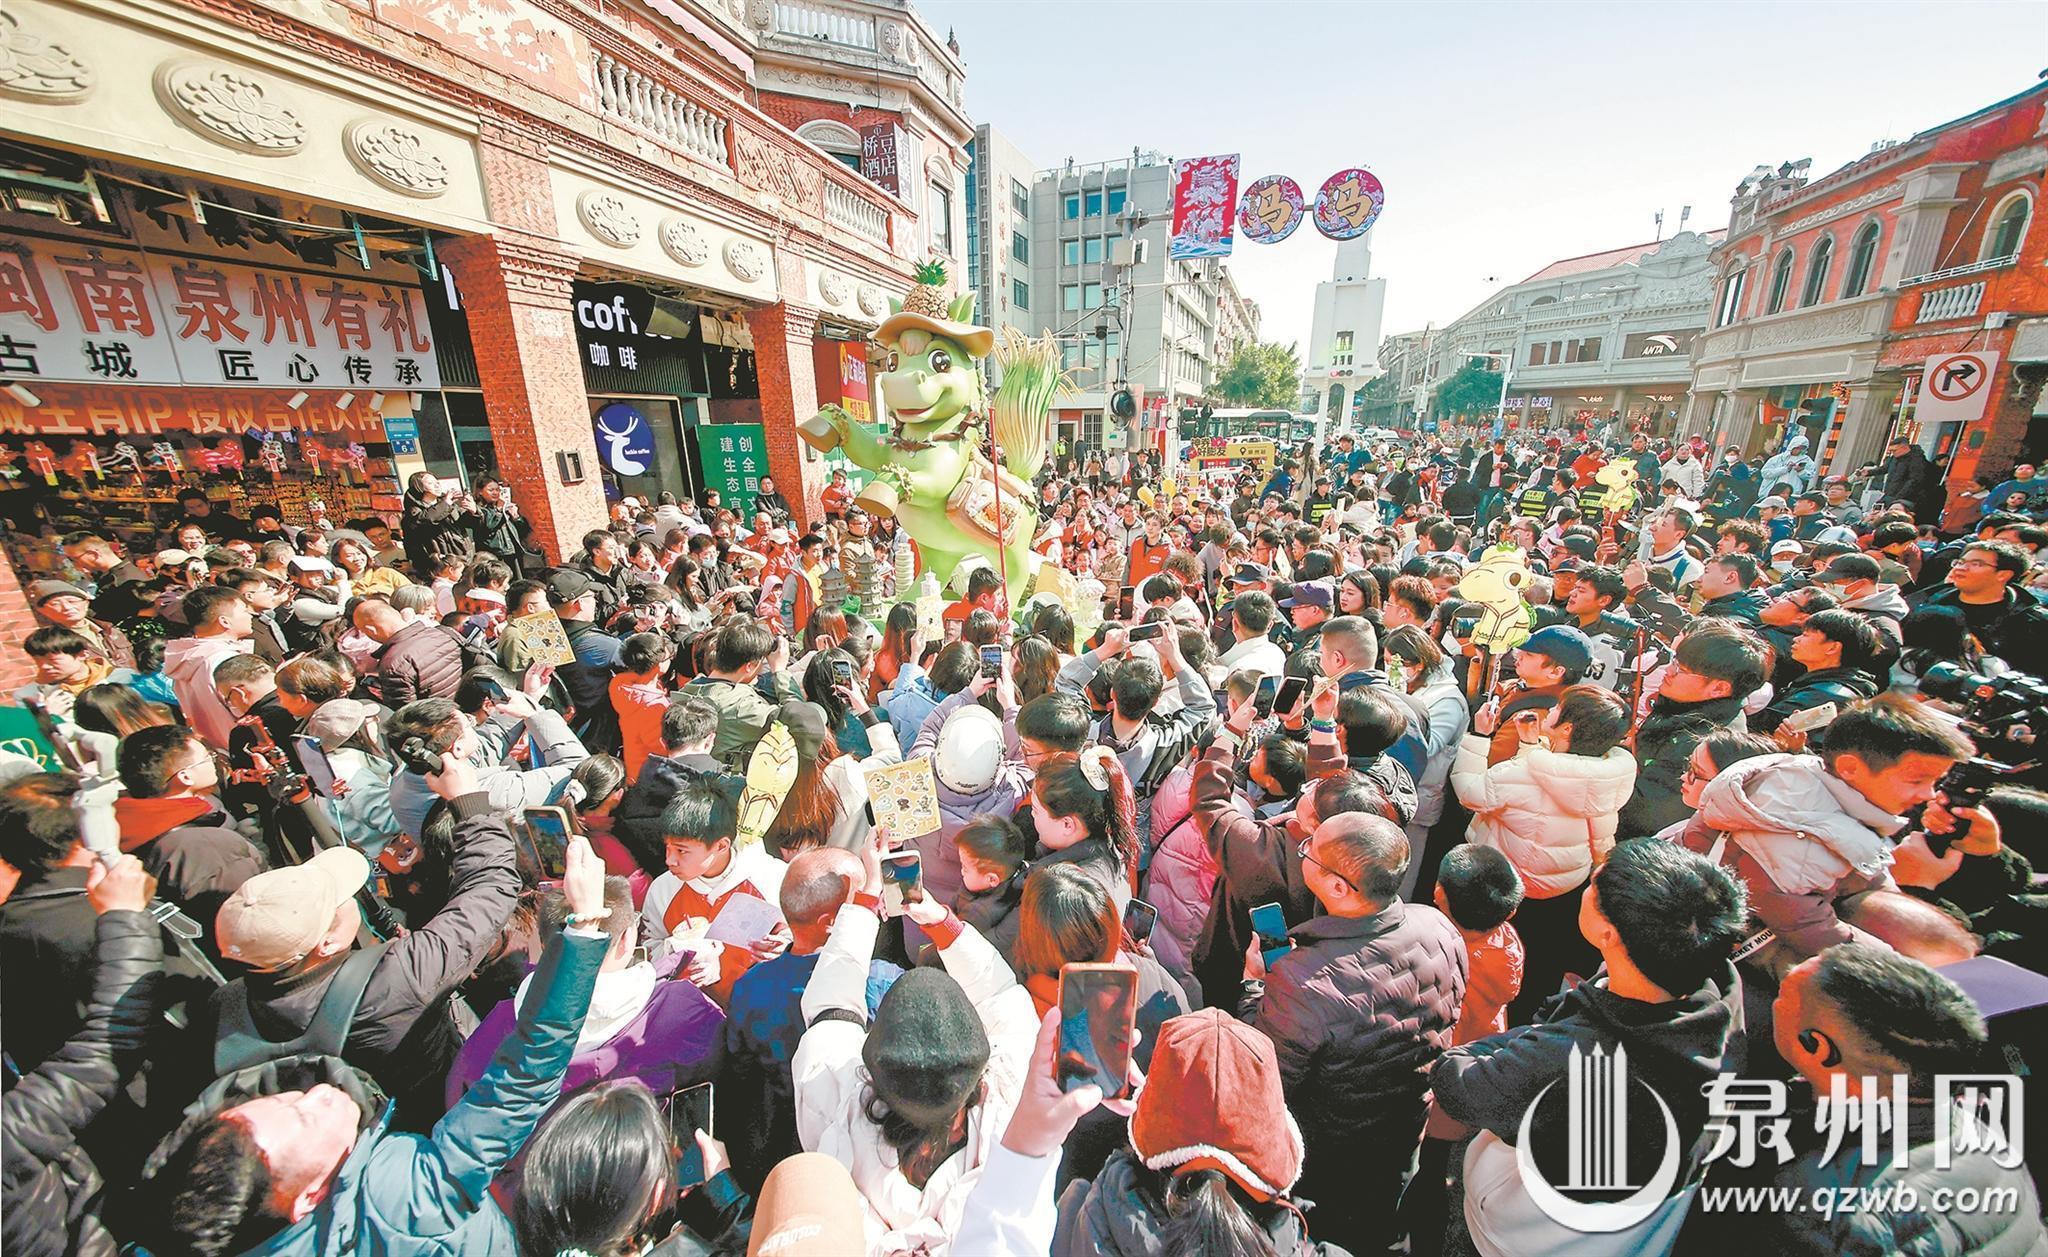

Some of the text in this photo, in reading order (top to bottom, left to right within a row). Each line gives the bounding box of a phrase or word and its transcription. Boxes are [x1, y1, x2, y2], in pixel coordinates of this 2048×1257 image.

[589, 341, 638, 370] 咖啡
[1641, 344, 1664, 356] ANTA
[218, 349, 422, 385] 匠心传承
[739, 436, 758, 528] 创全国文
[1754, 929, 1773, 946] MOU
